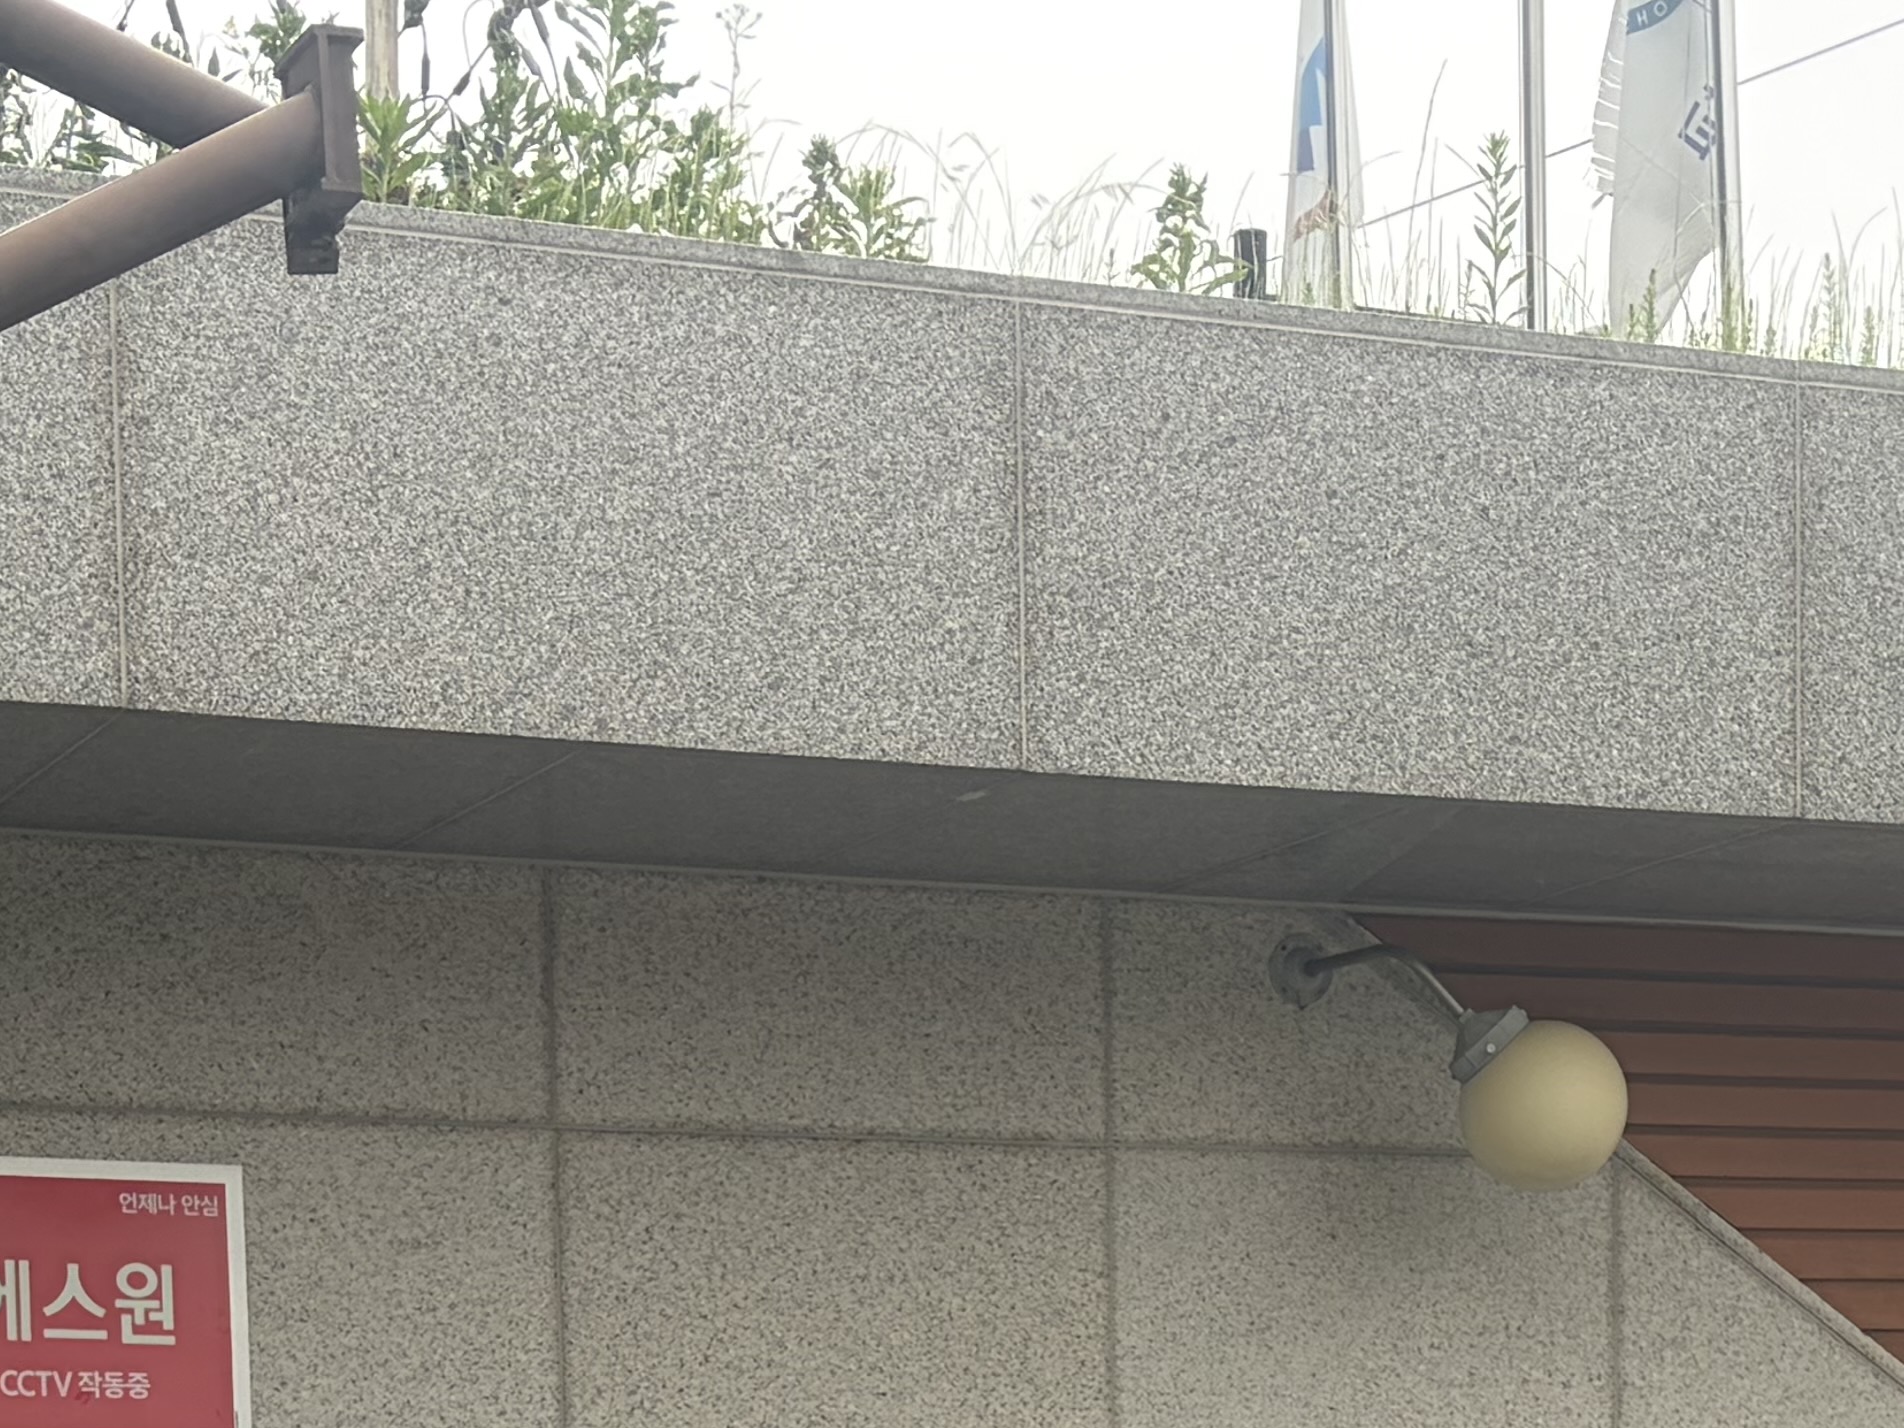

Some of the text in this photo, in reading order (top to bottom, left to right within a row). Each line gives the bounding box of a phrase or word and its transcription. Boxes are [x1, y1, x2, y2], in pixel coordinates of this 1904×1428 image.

[119, 1193, 219, 1217] 언제나 안심
[0, 1369, 151, 1400] CCTV 작동중
